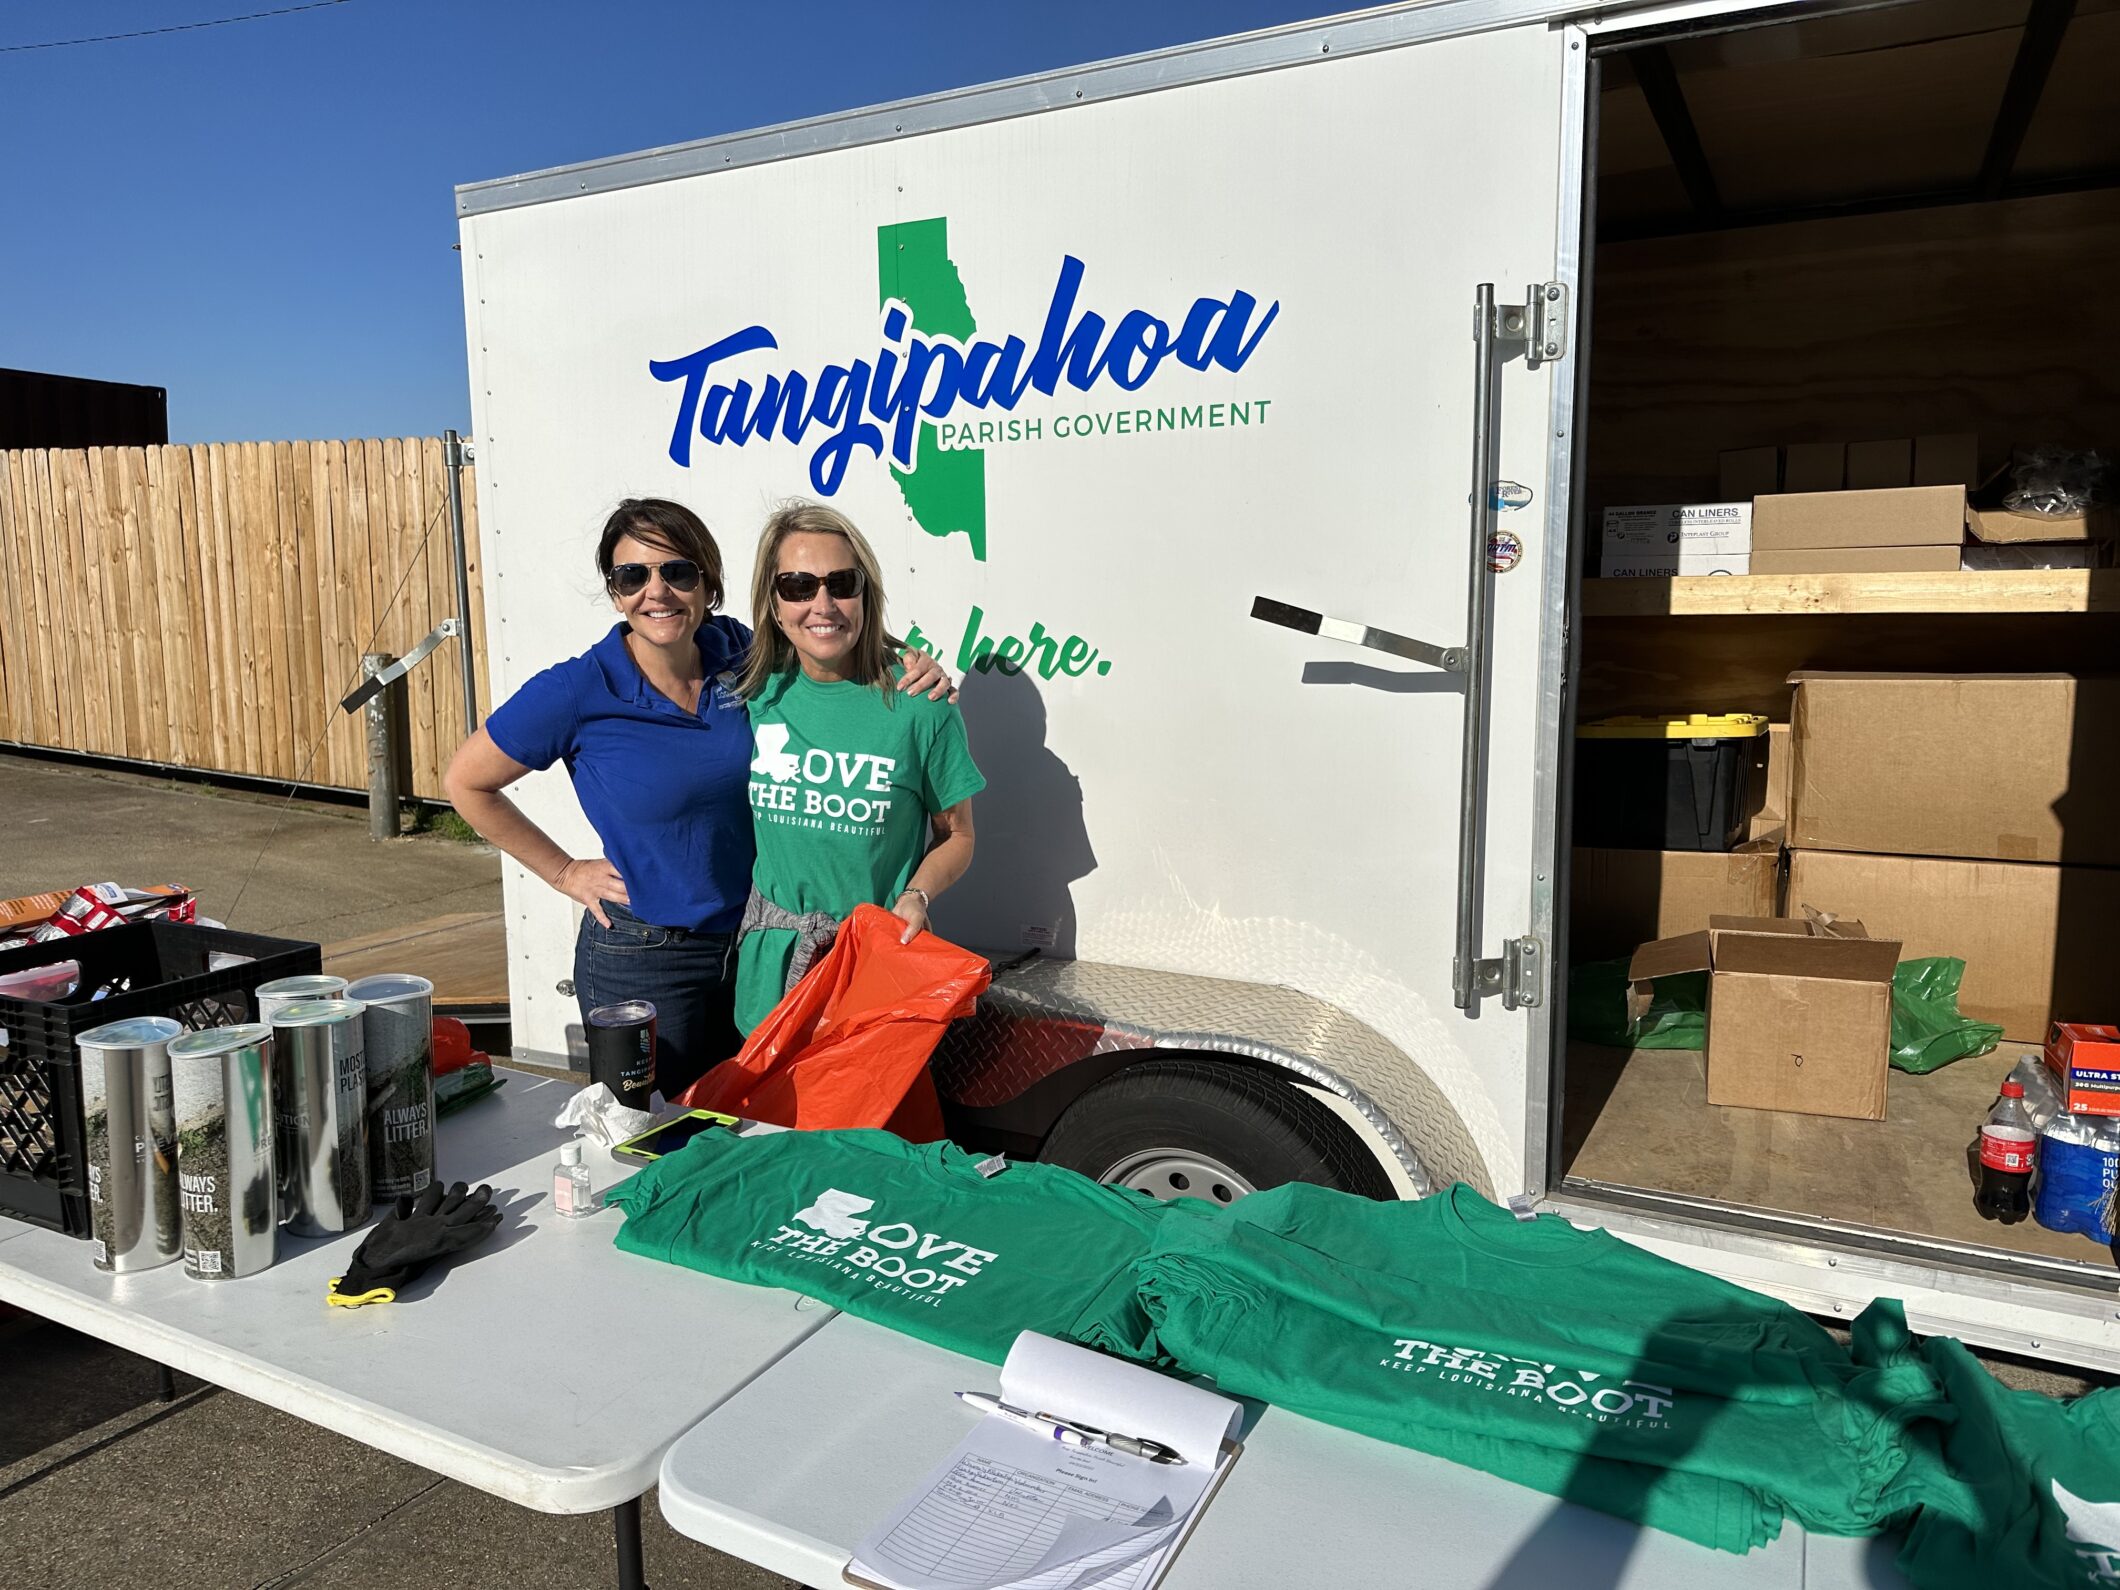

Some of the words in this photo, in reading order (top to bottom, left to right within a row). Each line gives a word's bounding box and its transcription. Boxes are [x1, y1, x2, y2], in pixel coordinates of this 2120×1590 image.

[649, 254, 1280, 497] Tangipahoa
[941, 419, 1043, 446] PARISH
[1053, 400, 1272, 437] GOVERNMENT
[1672, 508, 1696, 519] CAN
[1698, 507, 1739, 518] LINERS
[1613, 568, 1636, 577] CAN
[1639, 568, 1678, 577] LINERS
[957, 605, 1112, 681] here.
[749, 781, 797, 812] THE
[803, 789, 892, 823] BOOT
[768, 813, 823, 830] LOUISIANA
[830, 822, 886, 836] BEAUTIFUL
[2075, 1070, 2108, 1080] ULTRA
[384, 1102, 427, 1125] ALWAYS
[2073, 1103, 2088, 1111] 25
[385, 1120, 429, 1143] LITTER.
[769, 1225, 850, 1256] THE
[844, 1246, 967, 1295] BOOT
[865, 1274, 943, 1308] BEAUTIFUL
[1379, 1358, 1426, 1373] KEEP
[1438, 1371, 1542, 1404] LOUISIANA
[1393, 1339, 1502, 1380] THE
[1509, 1368, 1673, 1418] BOOT
